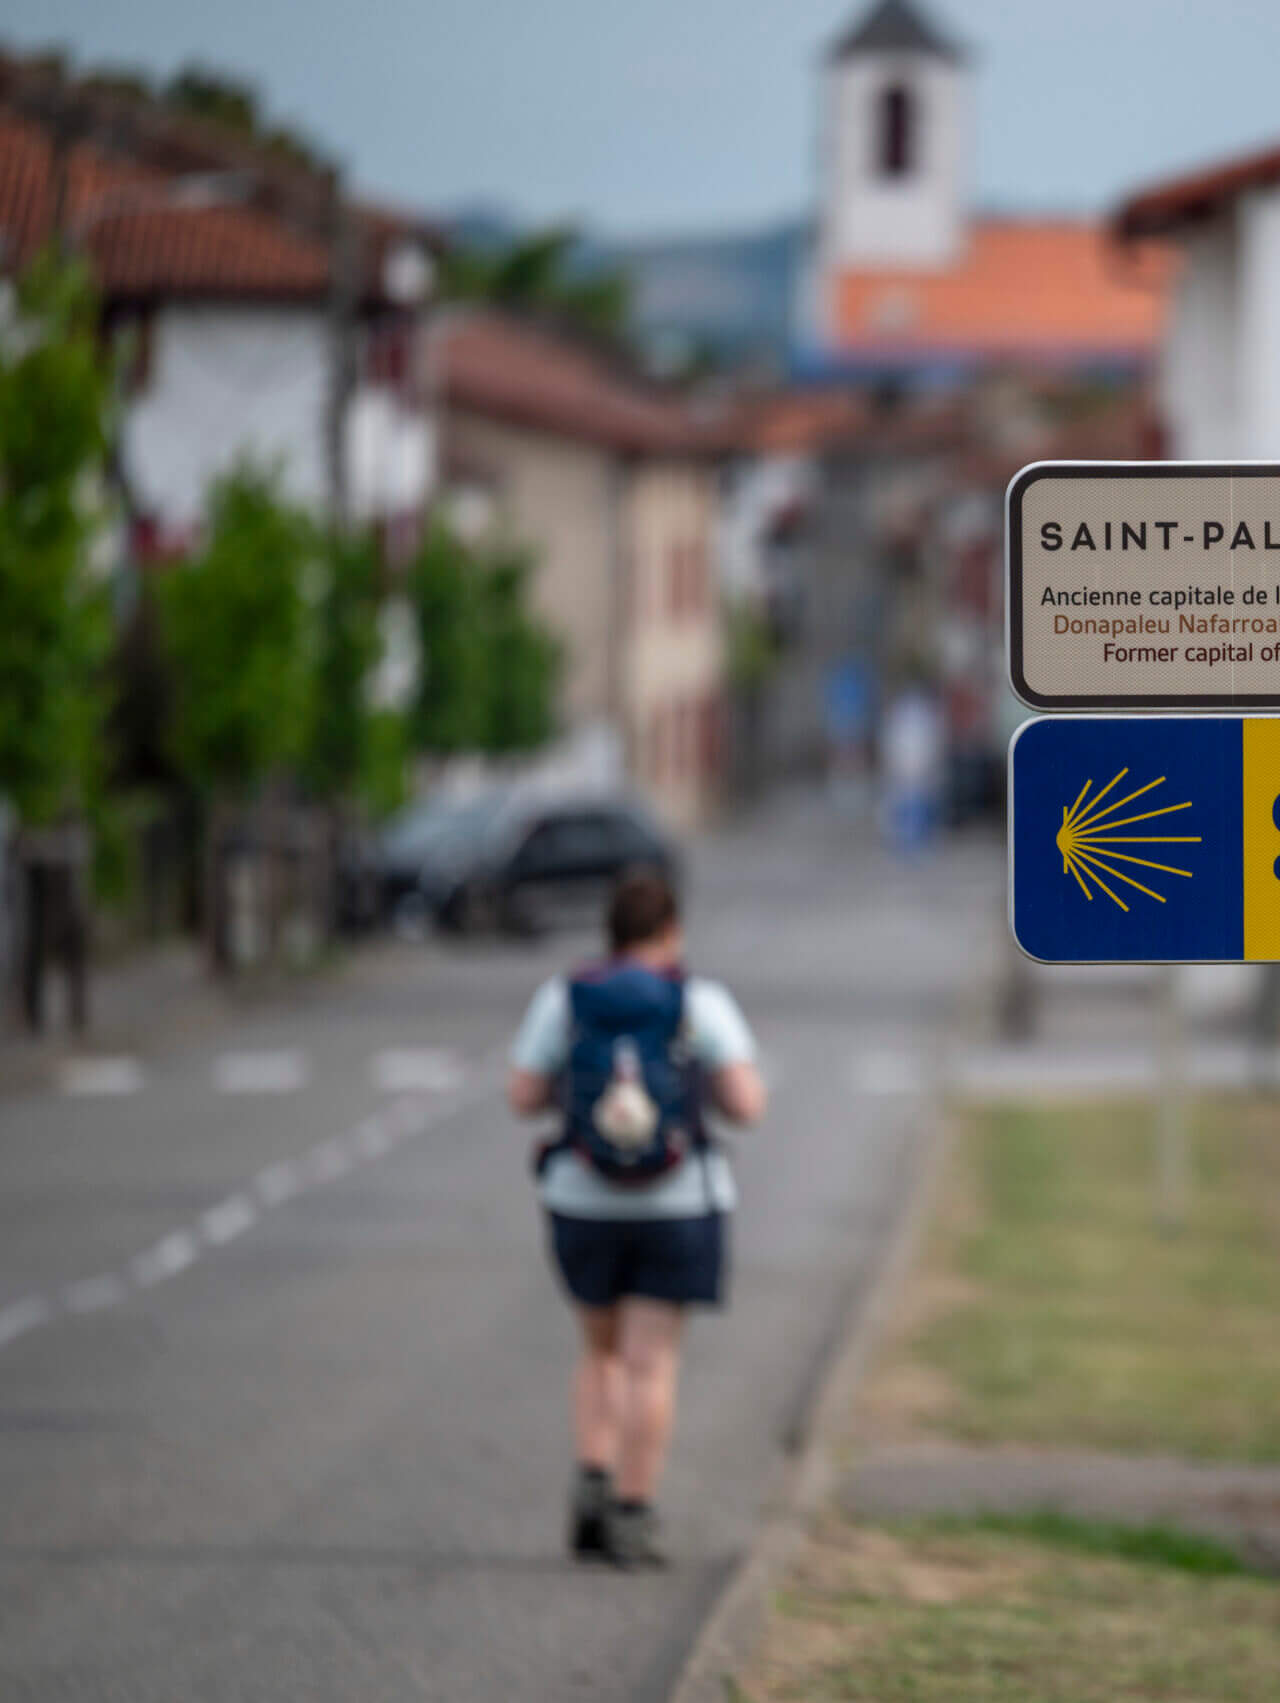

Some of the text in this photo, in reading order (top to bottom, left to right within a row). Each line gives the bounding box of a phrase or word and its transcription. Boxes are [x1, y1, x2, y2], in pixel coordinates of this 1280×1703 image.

[1041, 587, 1142, 607] Ancienne
[1149, 586, 1235, 610] capitale
[1242, 586, 1268, 606] de
[1053, 614, 1170, 639] Donapaleu
[1104, 643, 1179, 664] Former
[1185, 643, 1254, 668] capital
